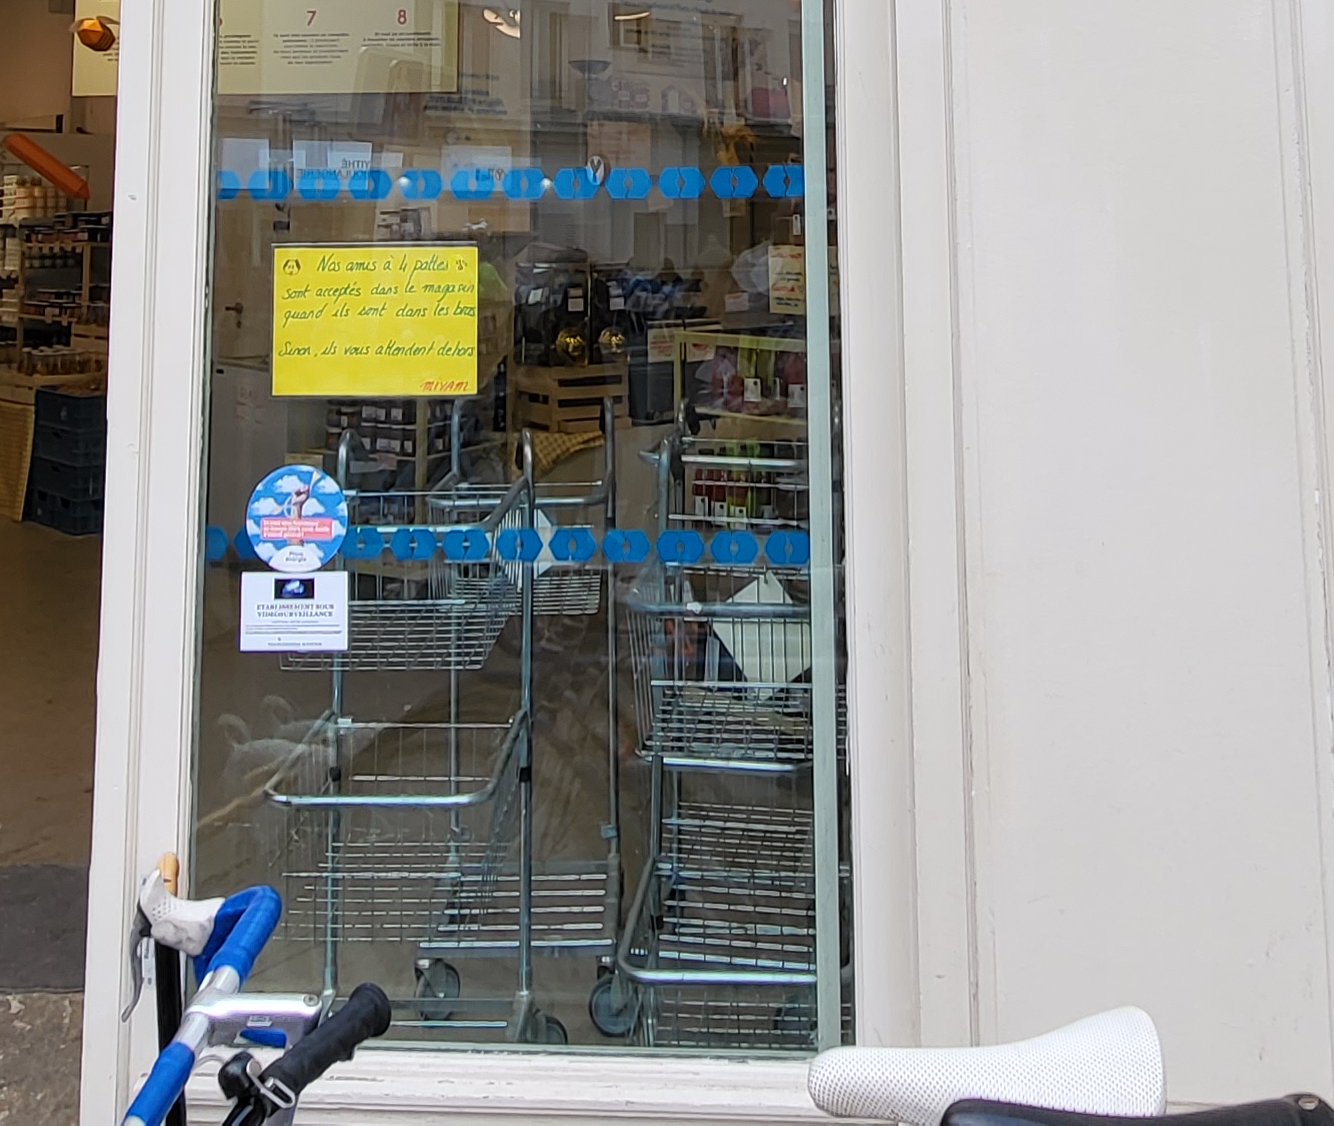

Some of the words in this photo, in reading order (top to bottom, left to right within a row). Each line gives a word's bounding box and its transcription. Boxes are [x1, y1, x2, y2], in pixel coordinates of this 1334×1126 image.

[306, 9, 317, 26] 7
[397, 9, 407, 25] 8
[317, 253, 341, 272] Nos
[346, 258, 377, 272] amis
[383, 255, 394, 272] à
[399, 253, 407, 273] 4
[411, 253, 449, 279] pattes
[282, 284, 310, 300] sont
[315, 282, 362, 304] acceptés
[370, 283, 398, 295] dans
[404, 278, 416, 294] le
[422, 282, 474, 303] magasin
[283, 303, 328, 328] quand
[332, 302, 350, 318] ils
[358, 302, 387, 317] sont
[396, 303, 428, 317] dans
[434, 303, 449, 317] les
[453, 301, 476, 317] bras
[320, 341, 338, 356] ils
[344, 345, 370, 356] vous
[375, 339, 434, 357] attendent
